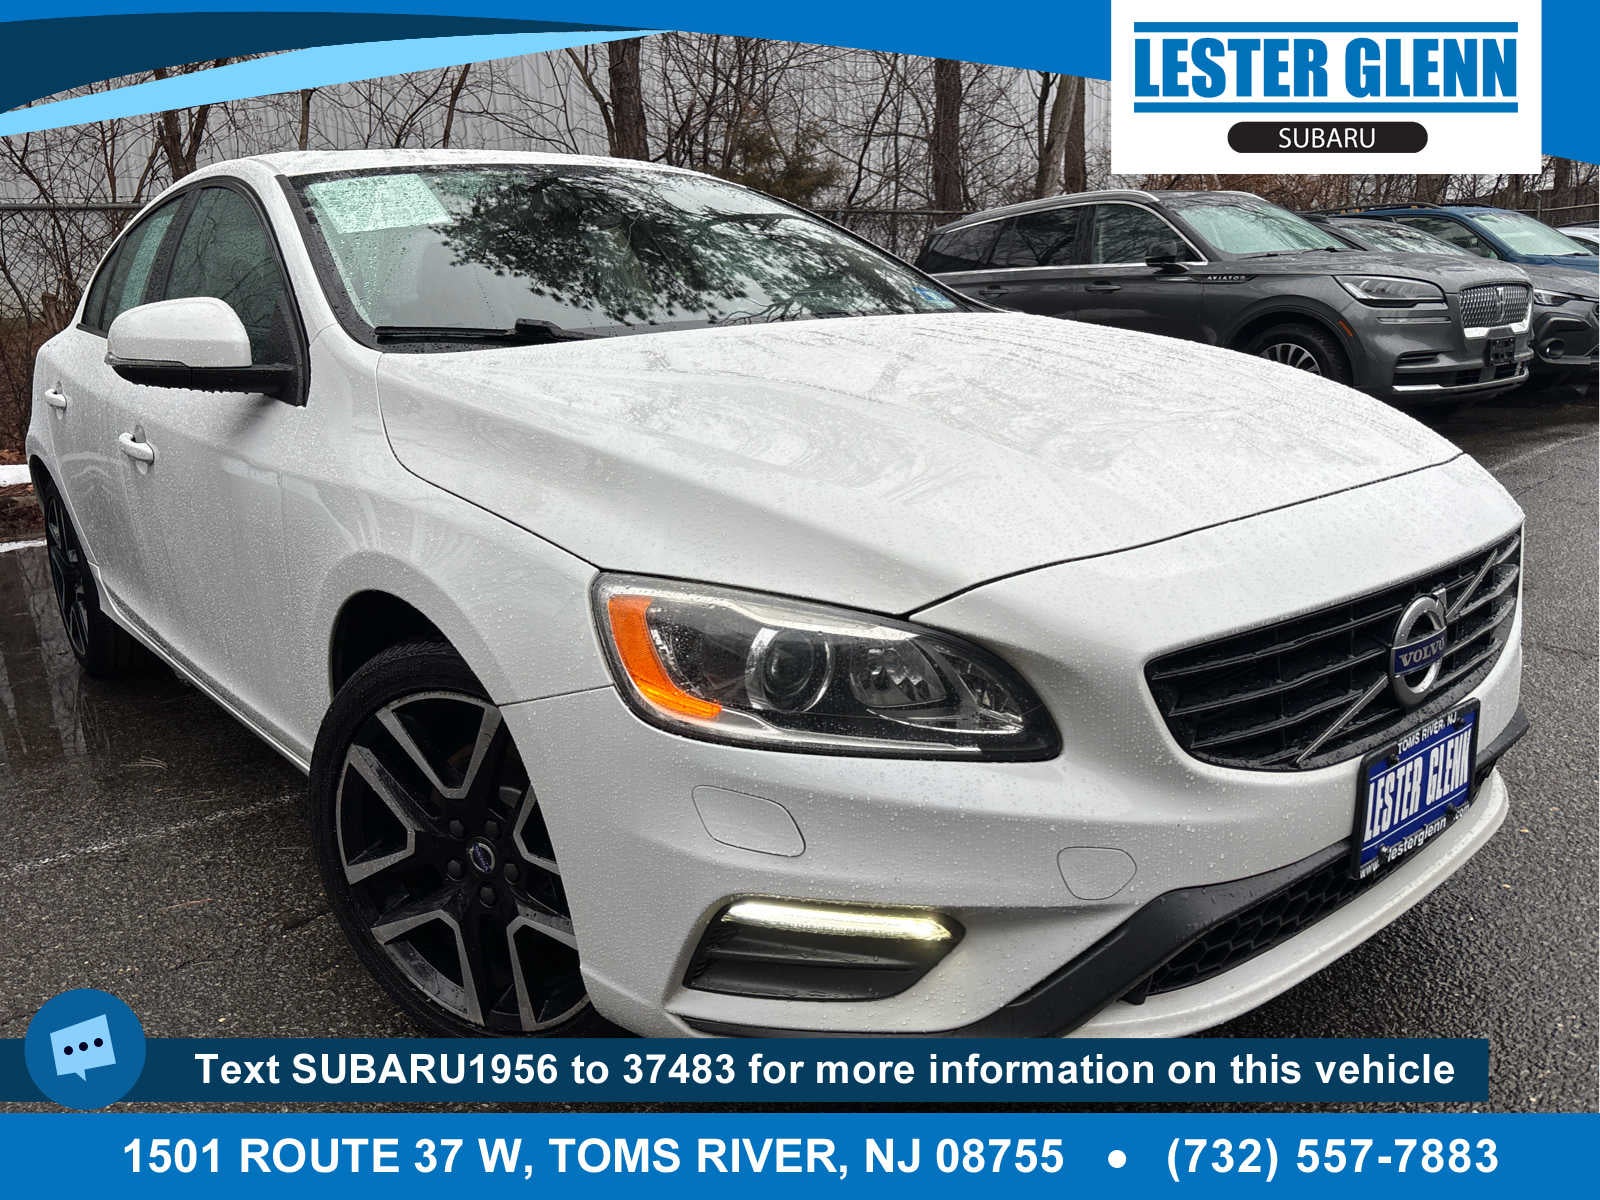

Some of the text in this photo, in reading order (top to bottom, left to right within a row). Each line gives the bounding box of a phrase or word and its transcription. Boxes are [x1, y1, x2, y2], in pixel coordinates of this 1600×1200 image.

[1399, 637, 1445, 667] VOLVO
[1397, 732, 1421, 754] TOMS
[1446, 711, 1458, 727] NJ
[1363, 728, 1472, 843] LESTER GLENN
